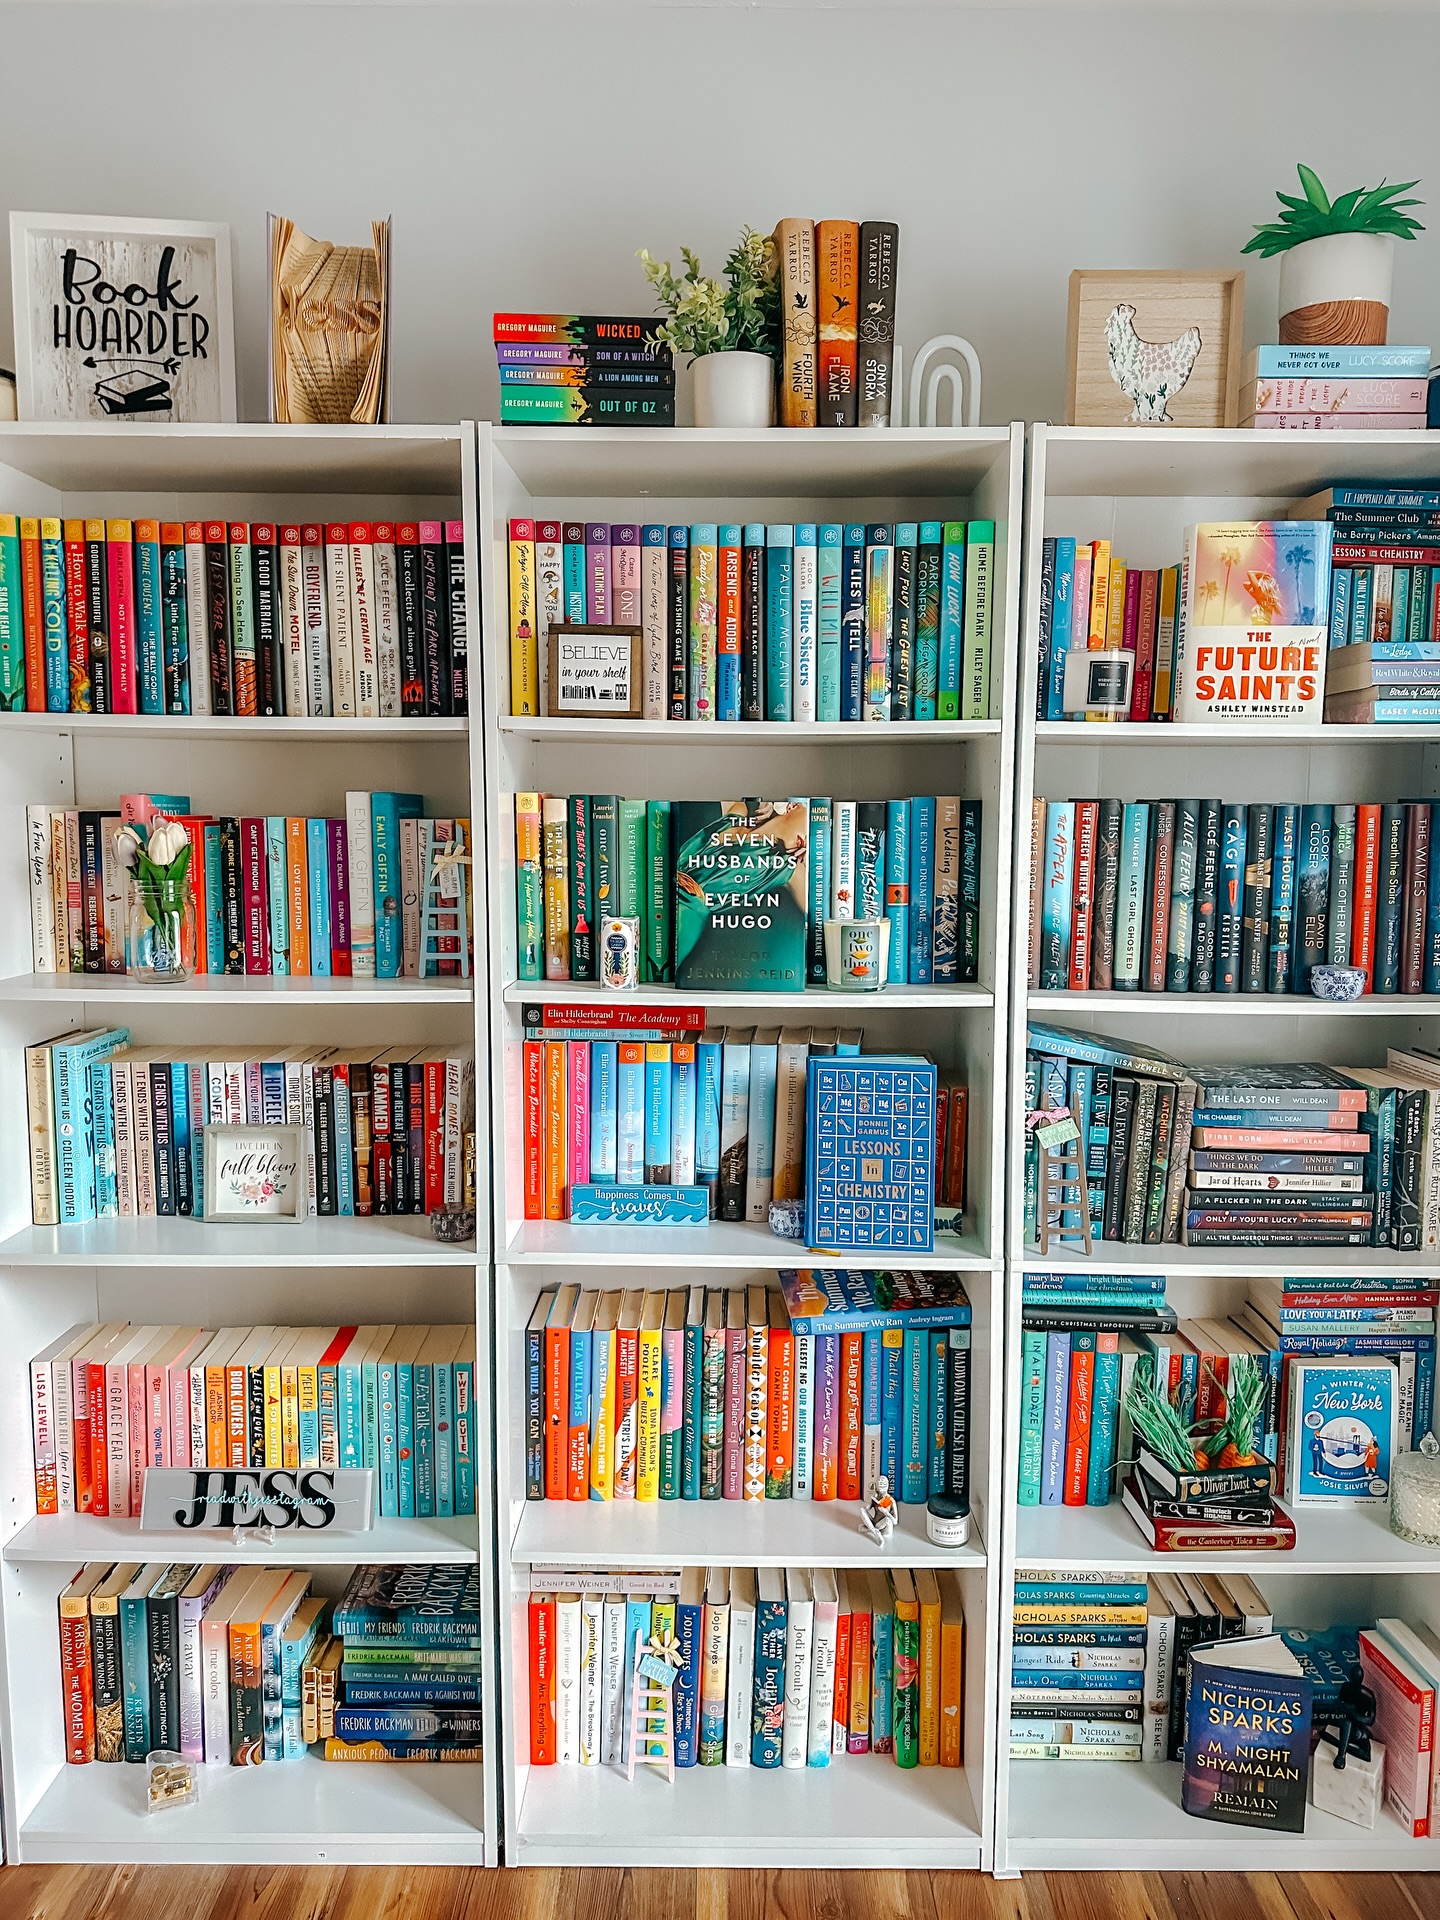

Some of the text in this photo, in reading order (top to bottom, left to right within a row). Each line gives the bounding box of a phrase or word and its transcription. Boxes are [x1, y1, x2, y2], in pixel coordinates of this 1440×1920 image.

[789, 234, 797, 279] YARROS
[802, 231, 810, 285] REBECCA
[830, 237, 838, 283] YARROS
[869, 239, 877, 284] YARROS
[882, 235, 891, 289] REBECCA
[61, 246, 198, 311] Book
[54, 304, 209, 359] HOARDER
[498, 323, 526, 331] GREGORY
[597, 324, 640, 338] WICKED
[596, 352, 654, 361] SON OF A WITCH
[793, 361, 802, 393] WING
[803, 354, 813, 400] FOURTH
[829, 357, 840, 401] FLAME
[840, 365, 850, 394] IRON
[866, 360, 877, 400] STORM
[877, 364, 887, 397] ONYX
[600, 401, 656, 413] OUT OF OZ
[1335, 512, 1419, 523] The Summer Club
[259, 560, 269, 586] GOOD
[727, 551, 738, 596] ARSENIC
[975, 548, 987, 637] HOME BEFORE DARK
[73, 553, 87, 666] How to Walk Away
[260, 591, 272, 640] MARRIAGE
[725, 617, 737, 650] ADOBO
[1247, 632, 1271, 642] THE
[562, 645, 627, 660] BELIEVE
[1196, 647, 1319, 671] FUTURE
[562, 666, 627, 679] in your shelf
[973, 648, 983, 703] RILEY SAGER
[1196, 676, 1316, 701] SAINTS
[1208, 705, 1304, 713] ASHLEY WINSTEAD
[730, 817, 756, 827] THE
[710, 833, 774, 846] SEVEN
[1309, 823, 1320, 868] CLOSER
[1321, 830, 1329, 861] LOOK
[376, 816, 388, 893] EMILY GIFFIN
[688, 855, 797, 869] HUSBANDS
[734, 874, 750, 883] OF
[704, 893, 780, 907] EVELYN
[1128, 902, 1136, 922] GIRL
[712, 915, 771, 929] HUGO
[1305, 917, 1315, 947] ELLIS
[1317, 914, 1325, 948] DAVID
[849, 930, 873, 940] one
[849, 943, 873, 953] two
[1126, 926, 1134, 969] GHOSTED
[844, 957, 878, 968] three
[548, 1009, 613, 1019] Elin Hilderbrand
[618, 1013, 680, 1025] The Academy
[374, 1073, 389, 1130] SLAMMED
[1213, 1095, 1280, 1104] THE LAST ONE
[235, 1142, 254, 1151] LIVE
[256, 1143, 272, 1151] LIFE
[845, 1140, 900, 1156] LESSONS
[221, 1154, 296, 1179] full bloom
[867, 1165, 878, 1175] In
[595, 1189, 685, 1199] Happiness Comes In
[837, 1183, 906, 1199] CHEMISTRY
[611, 1200, 663, 1216] waves
[817, 1318, 902, 1331] The Summer We Ran
[909, 1314, 953, 1324] Audrey Ingram
[1330, 1381, 1363, 1389] WINTER
[37, 1373, 47, 1446] LISA JEWELL
[230, 1371, 243, 1436] BOOK LOVERS
[1313, 1392, 1383, 1410] New York
[1204, 1474, 1250, 1493] Oliver Twist
[1320, 1479, 1342, 1489] JOSIE
[1345, 1482, 1368, 1490] SILVER
[173, 1470, 336, 1529] JESS
[365, 1622, 406, 1633] MY FRIENDS
[412, 1623, 477, 1634] FREDRIK BACKMAN
[1071, 1614, 1106, 1622] SPARKS
[63, 1622, 74, 1670] HANNAH
[74, 1623, 86, 1668] KRISTIN
[682, 1615, 692, 1671] JOJO MOYES
[765, 1667, 778, 1741] Jodi Picoult
[1202, 1688, 1301, 1716] NICHOLAS
[72, 1691, 83, 1739] WOMEN
[1209, 1708, 1292, 1735] SPARKS
[1208, 1740, 1290, 1763] M. NIGHT
[1197, 1754, 1298, 1781] SHYAMALAN
[1213, 1792, 1278, 1810] REMAIN
